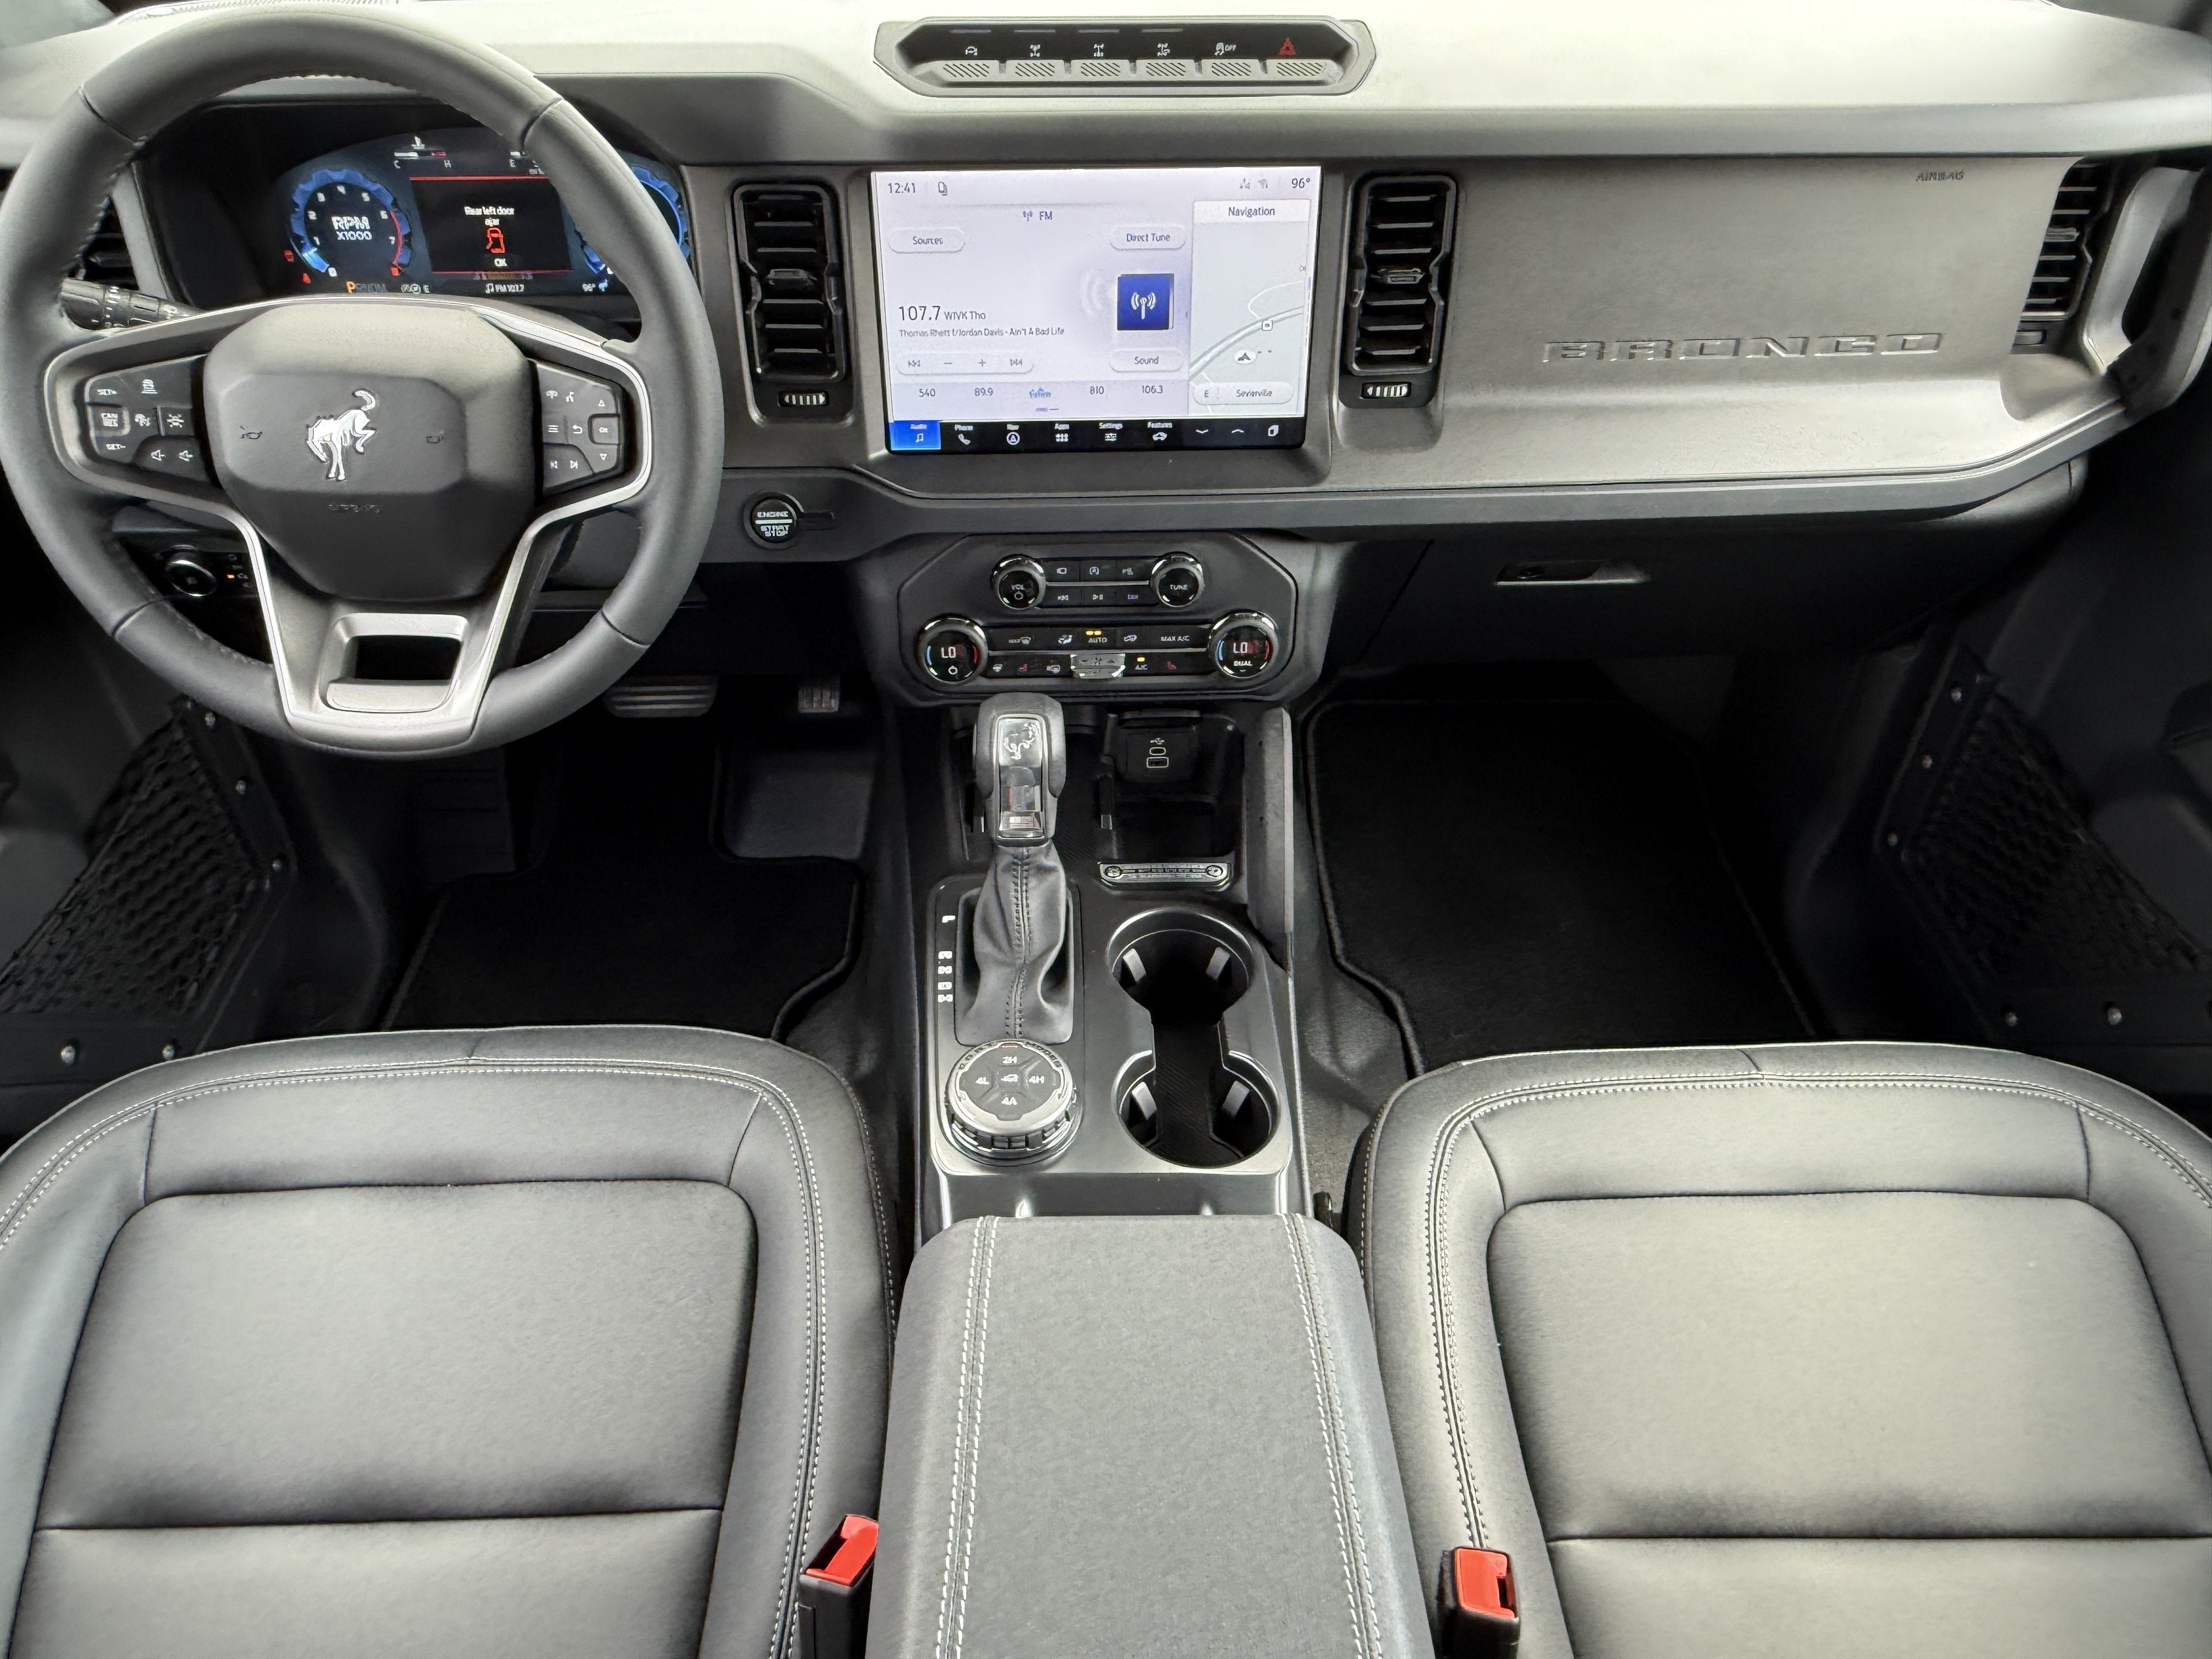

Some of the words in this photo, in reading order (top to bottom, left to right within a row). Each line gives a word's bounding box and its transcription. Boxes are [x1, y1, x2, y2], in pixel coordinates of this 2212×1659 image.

[888, 182, 916, 194] 12:41
[1291, 178, 1311, 189] 96°
[1040, 211, 1053, 221] FM
[1228, 207, 1276, 218] Navigation
[331, 216, 371, 230] RPM
[912, 236, 944, 245] Sources
[1126, 233, 1149, 242] Direct
[1151, 233, 1170, 242] Tune
[494, 258, 507, 267] OK
[899, 306, 941, 321] 107.7
[969, 311, 986, 320] Tho
[899, 329, 929, 337] Thomas
[984, 328, 1003, 336] Davis
[1035, 328, 1049, 336] Bad
[1542, 332, 1944, 363] BRONCO
[1134, 356, 1159, 365] Sound
[918, 388, 935, 397] 540
[1090, 386, 1104, 394] 810
[1002, 1056, 1018, 1064] 2H
[975, 1076, 990, 1085] 4L
[1001, 1096, 1018, 1105] 4A
